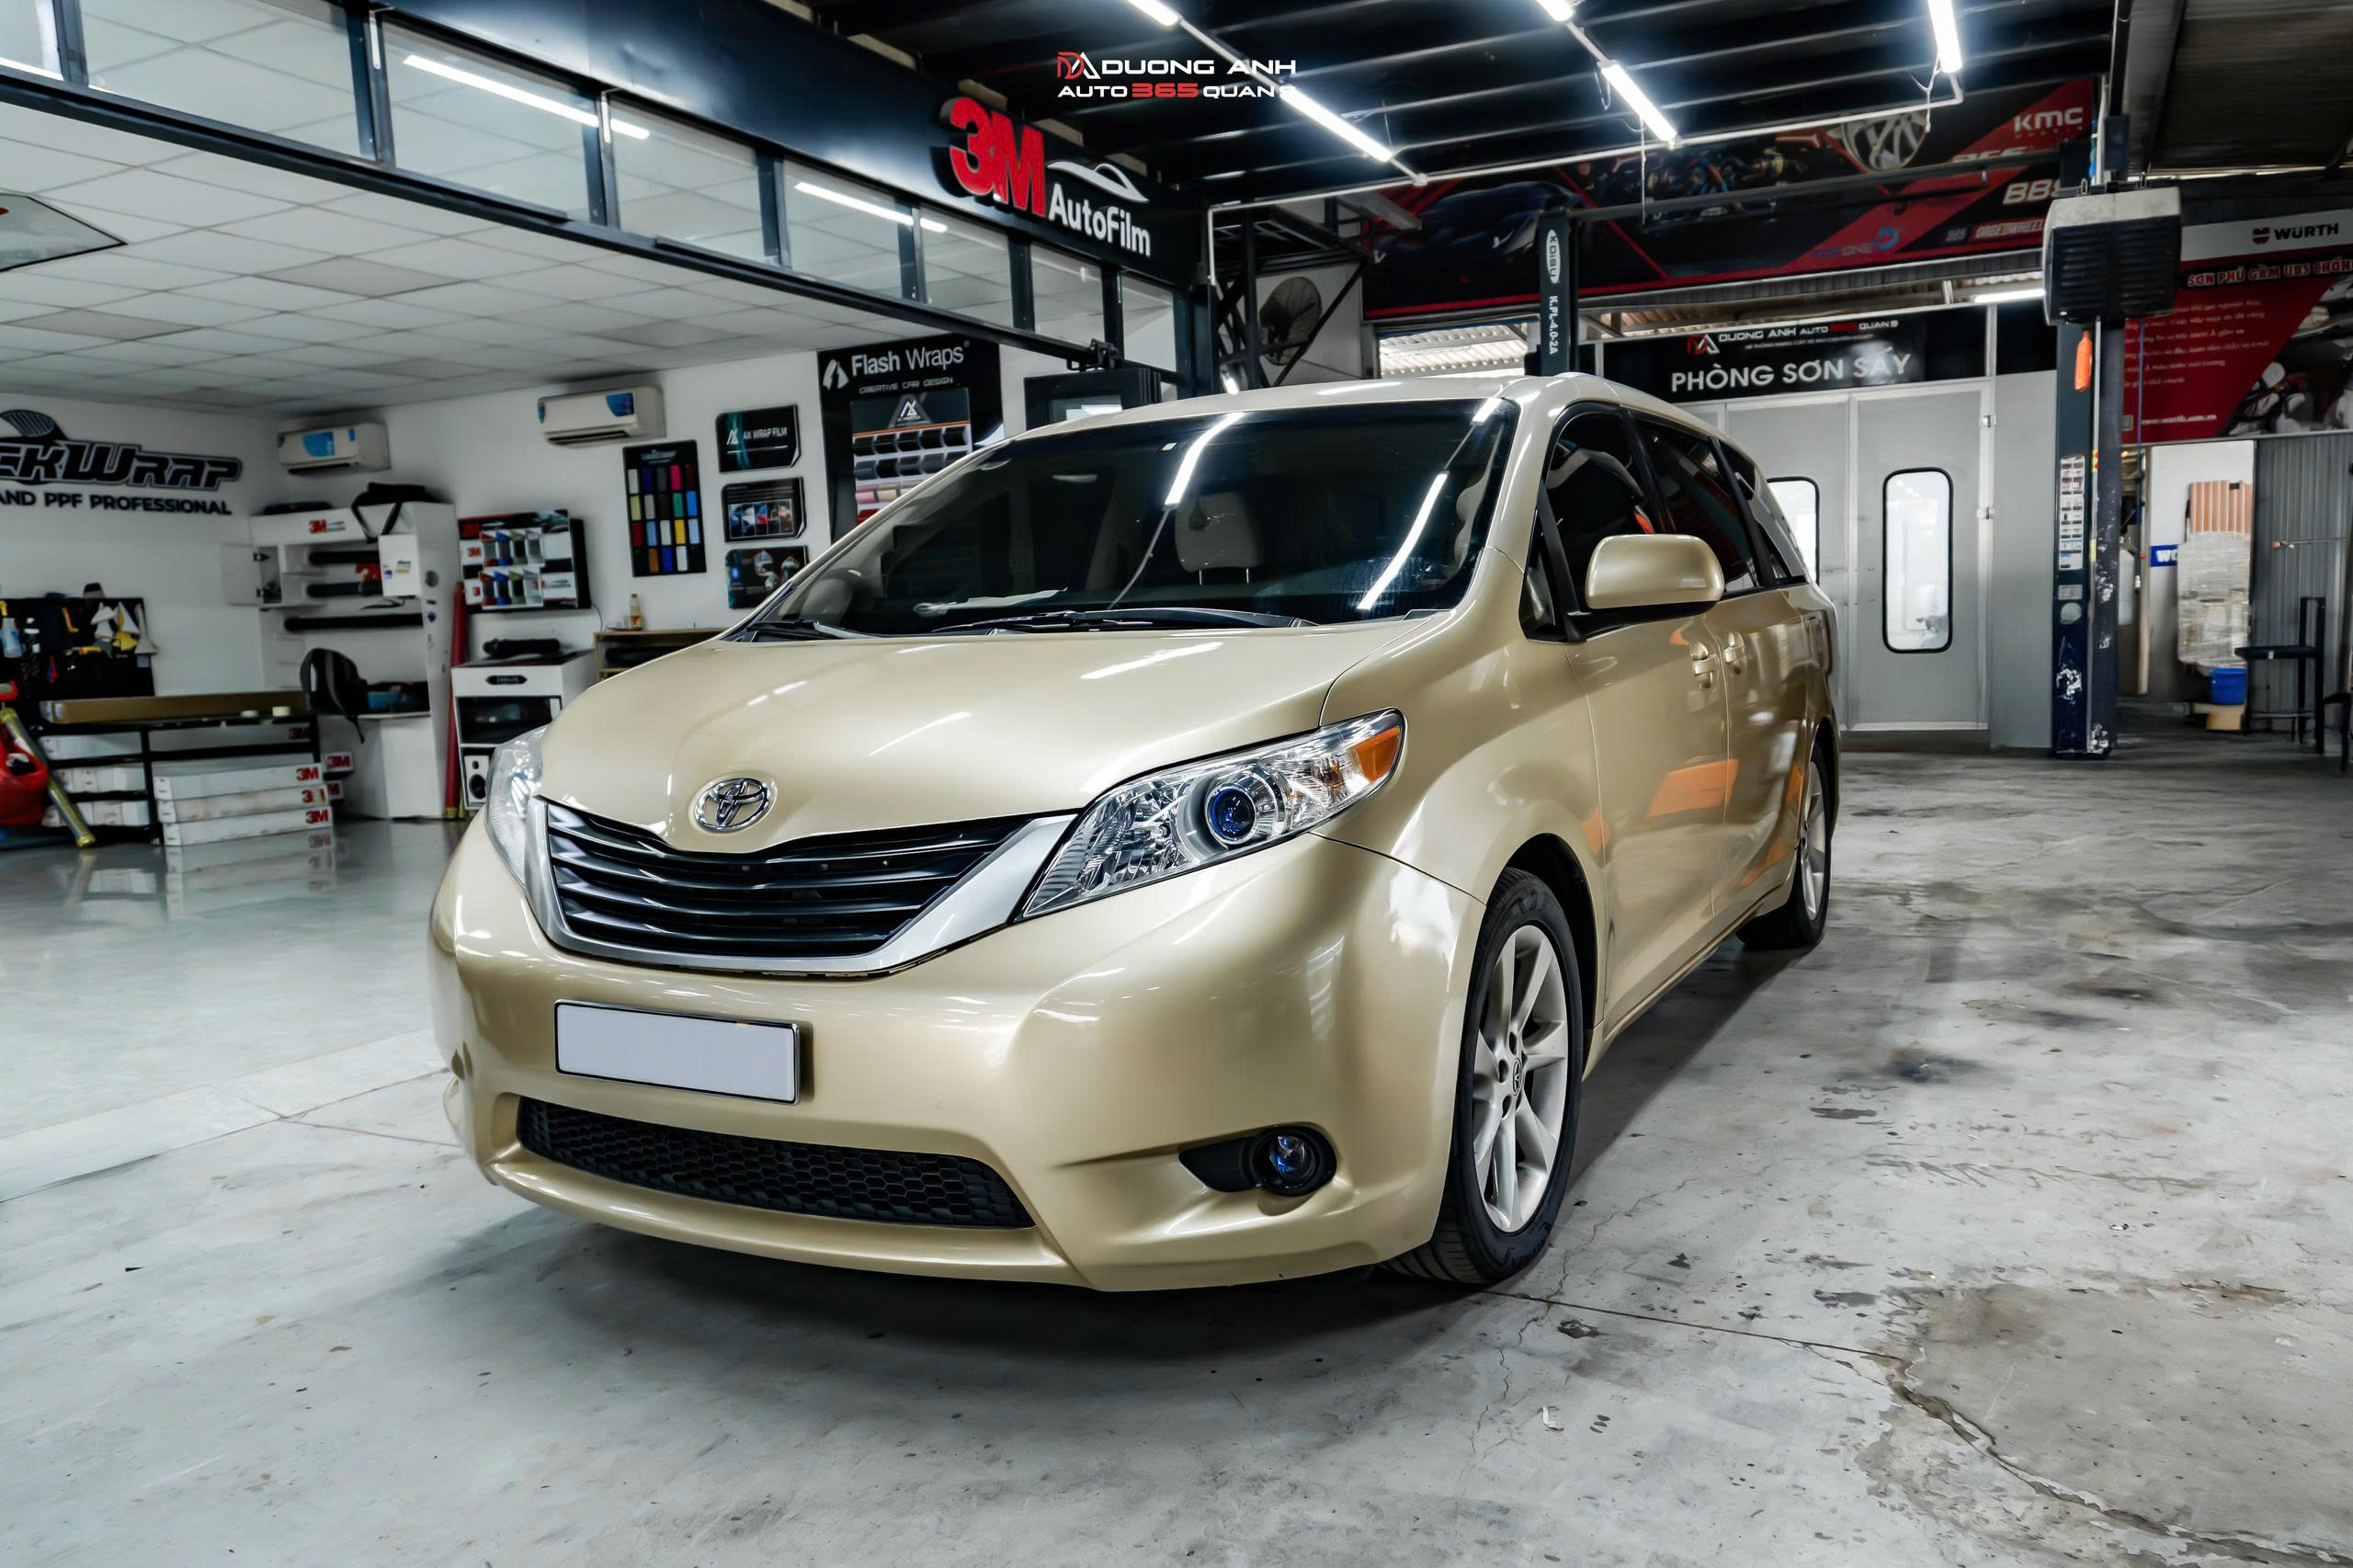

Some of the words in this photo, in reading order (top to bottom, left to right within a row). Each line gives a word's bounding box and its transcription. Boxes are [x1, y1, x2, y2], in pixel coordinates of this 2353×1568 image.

[949, 97, 1046, 218] 3M
[1048, 183, 1151, 257] AutoFilm
[1768, 328, 1797, 339] ANH
[1800, 326, 1828, 335] AUTO
[851, 351, 901, 377] Flash
[905, 346, 964, 370] Wraps
[1671, 363, 1775, 392] PHÒNG
[1782, 358, 1844, 382] SƠN
[858, 382, 898, 394] CREATIVE
[902, 380, 921, 390] CAR
[44, 492, 83, 508] PPF
[90, 494, 233, 515] PROFESSIONAL
[309, 519, 327, 534] 3M
[326, 756, 350, 768] 3M
[296, 767, 319, 780] 3M
[305, 808, 329, 824] 3M
